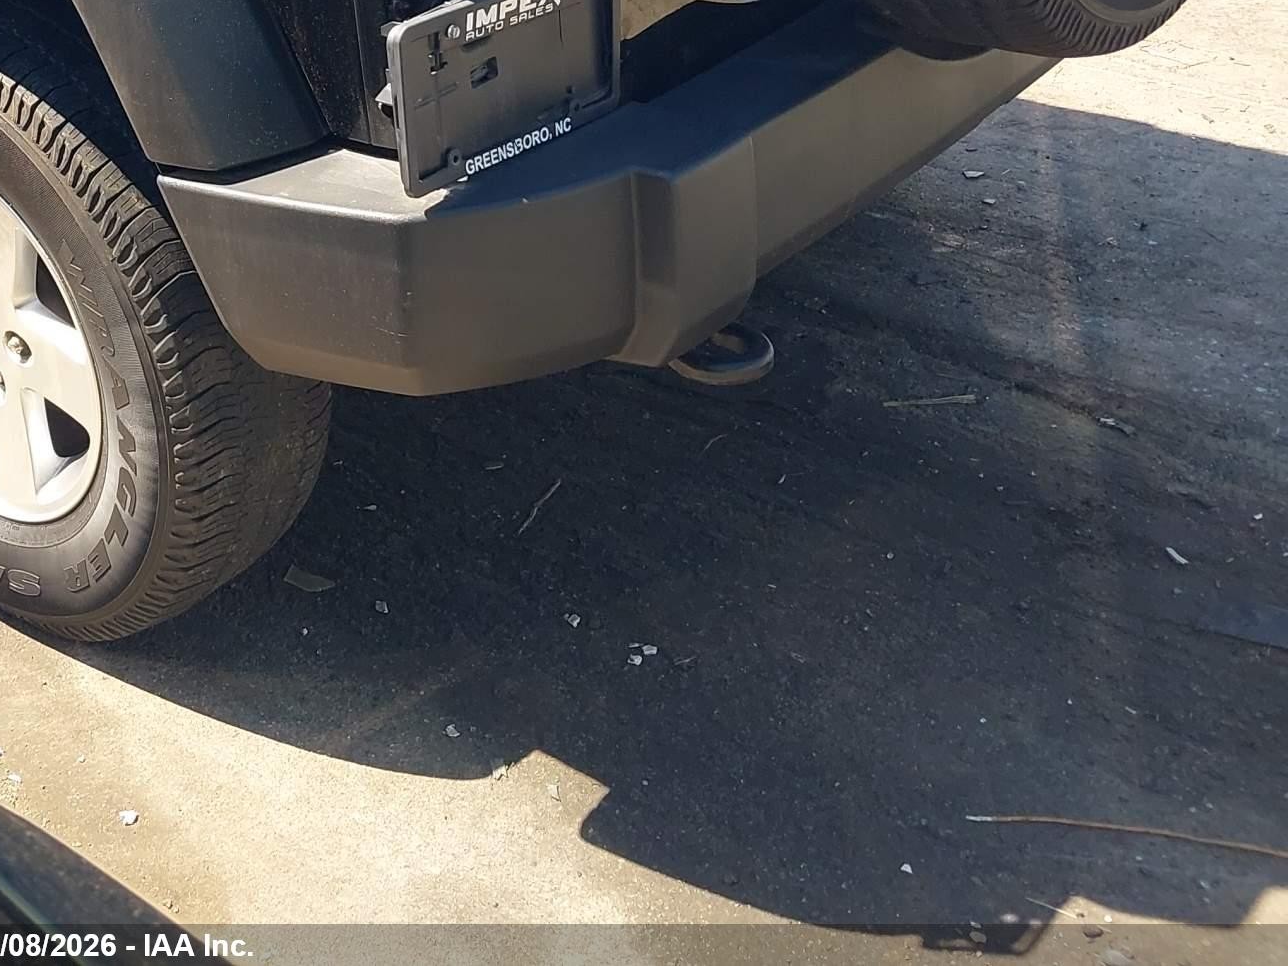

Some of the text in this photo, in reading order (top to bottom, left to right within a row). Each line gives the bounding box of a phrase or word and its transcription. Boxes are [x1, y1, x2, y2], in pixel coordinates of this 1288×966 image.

[465, 2, 554, 42] AUTO SALES
[465, 117, 572, 175] GREENSBORO, NC
[62, 239, 137, 594] WRANGLER
